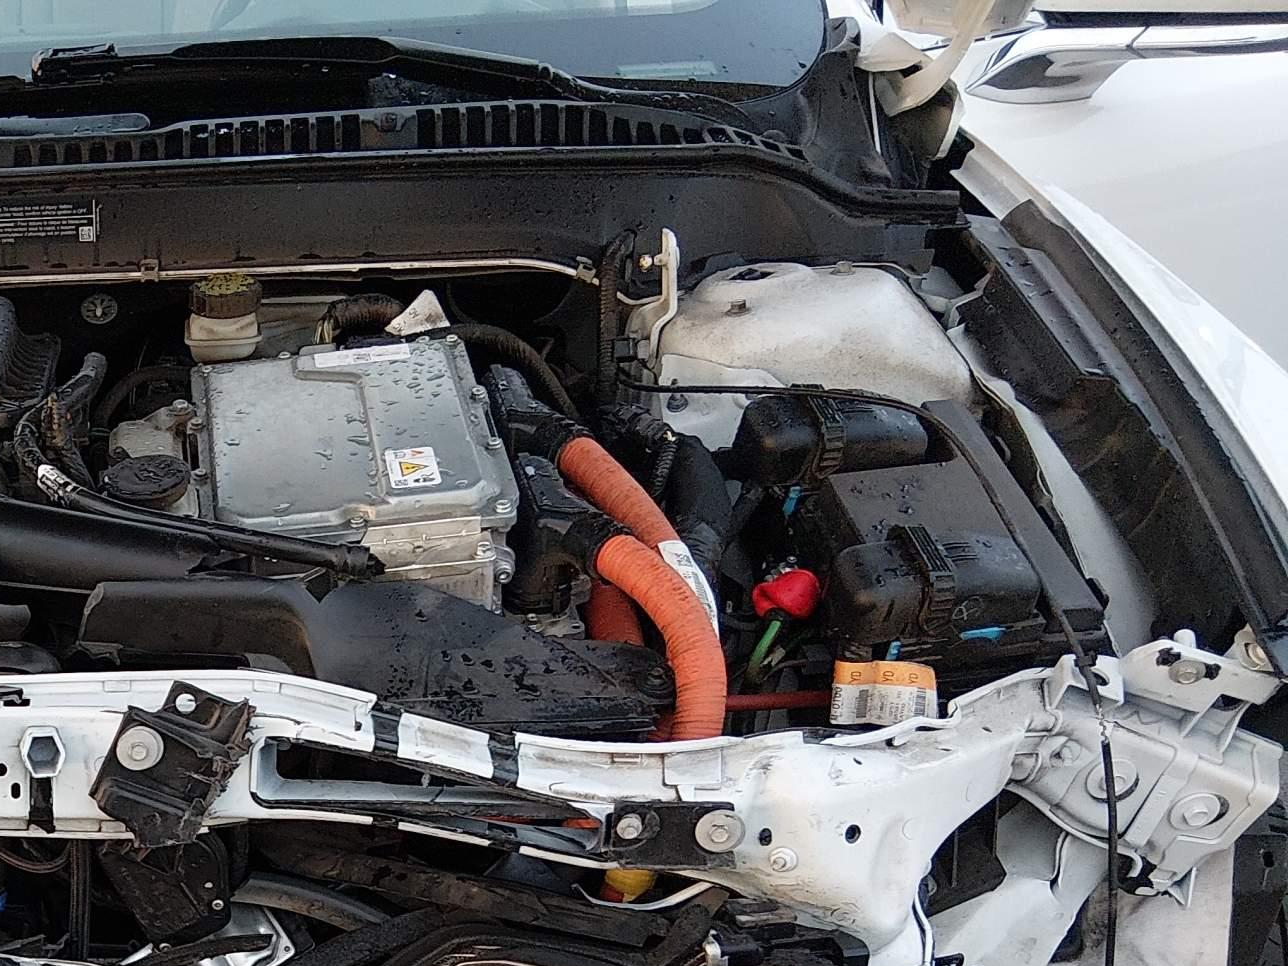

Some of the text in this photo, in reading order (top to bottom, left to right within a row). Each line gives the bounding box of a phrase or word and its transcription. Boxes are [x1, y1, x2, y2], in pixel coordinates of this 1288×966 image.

[848, 671, 862, 684] YD
[881, 670, 895, 682] YD
[908, 672, 919, 684] YD
